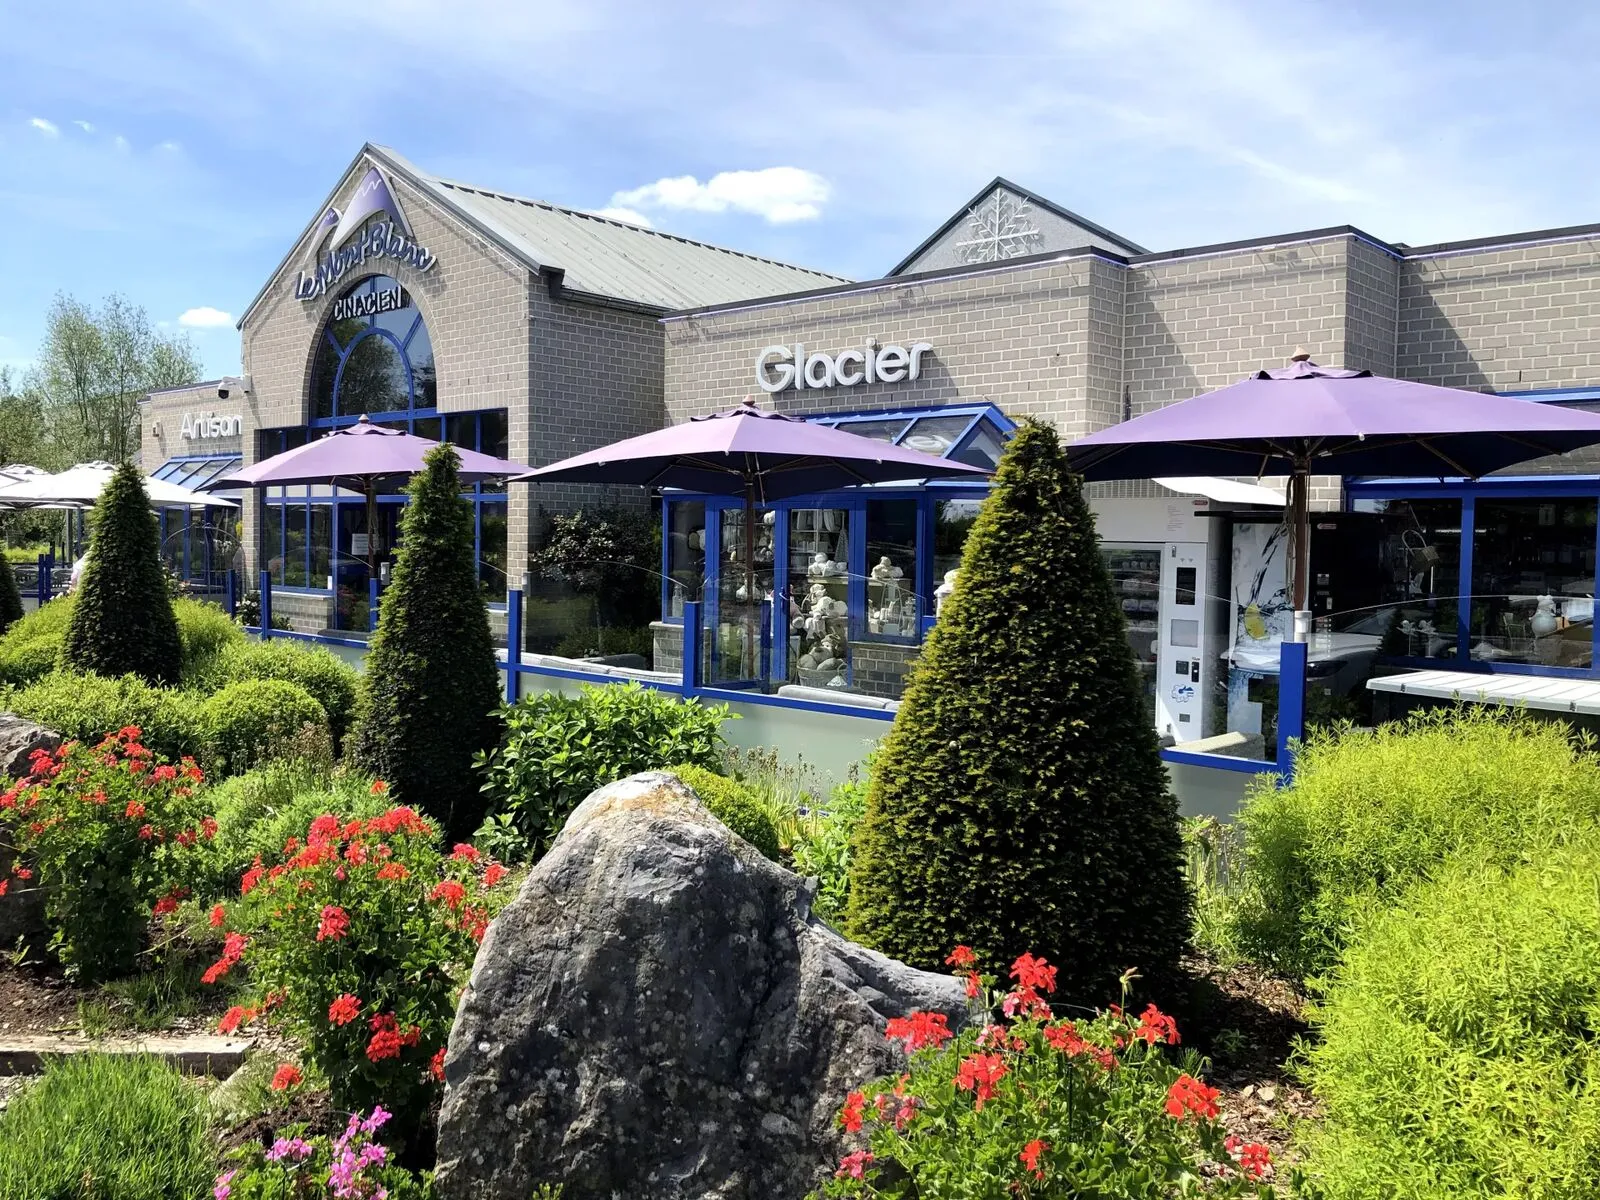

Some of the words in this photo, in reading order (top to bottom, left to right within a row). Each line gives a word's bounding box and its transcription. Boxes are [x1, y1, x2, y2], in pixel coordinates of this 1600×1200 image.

[369, 222, 437, 272] Blanc
[756, 338, 934, 393] Glacier
[180, 411, 243, 440] Artisan
